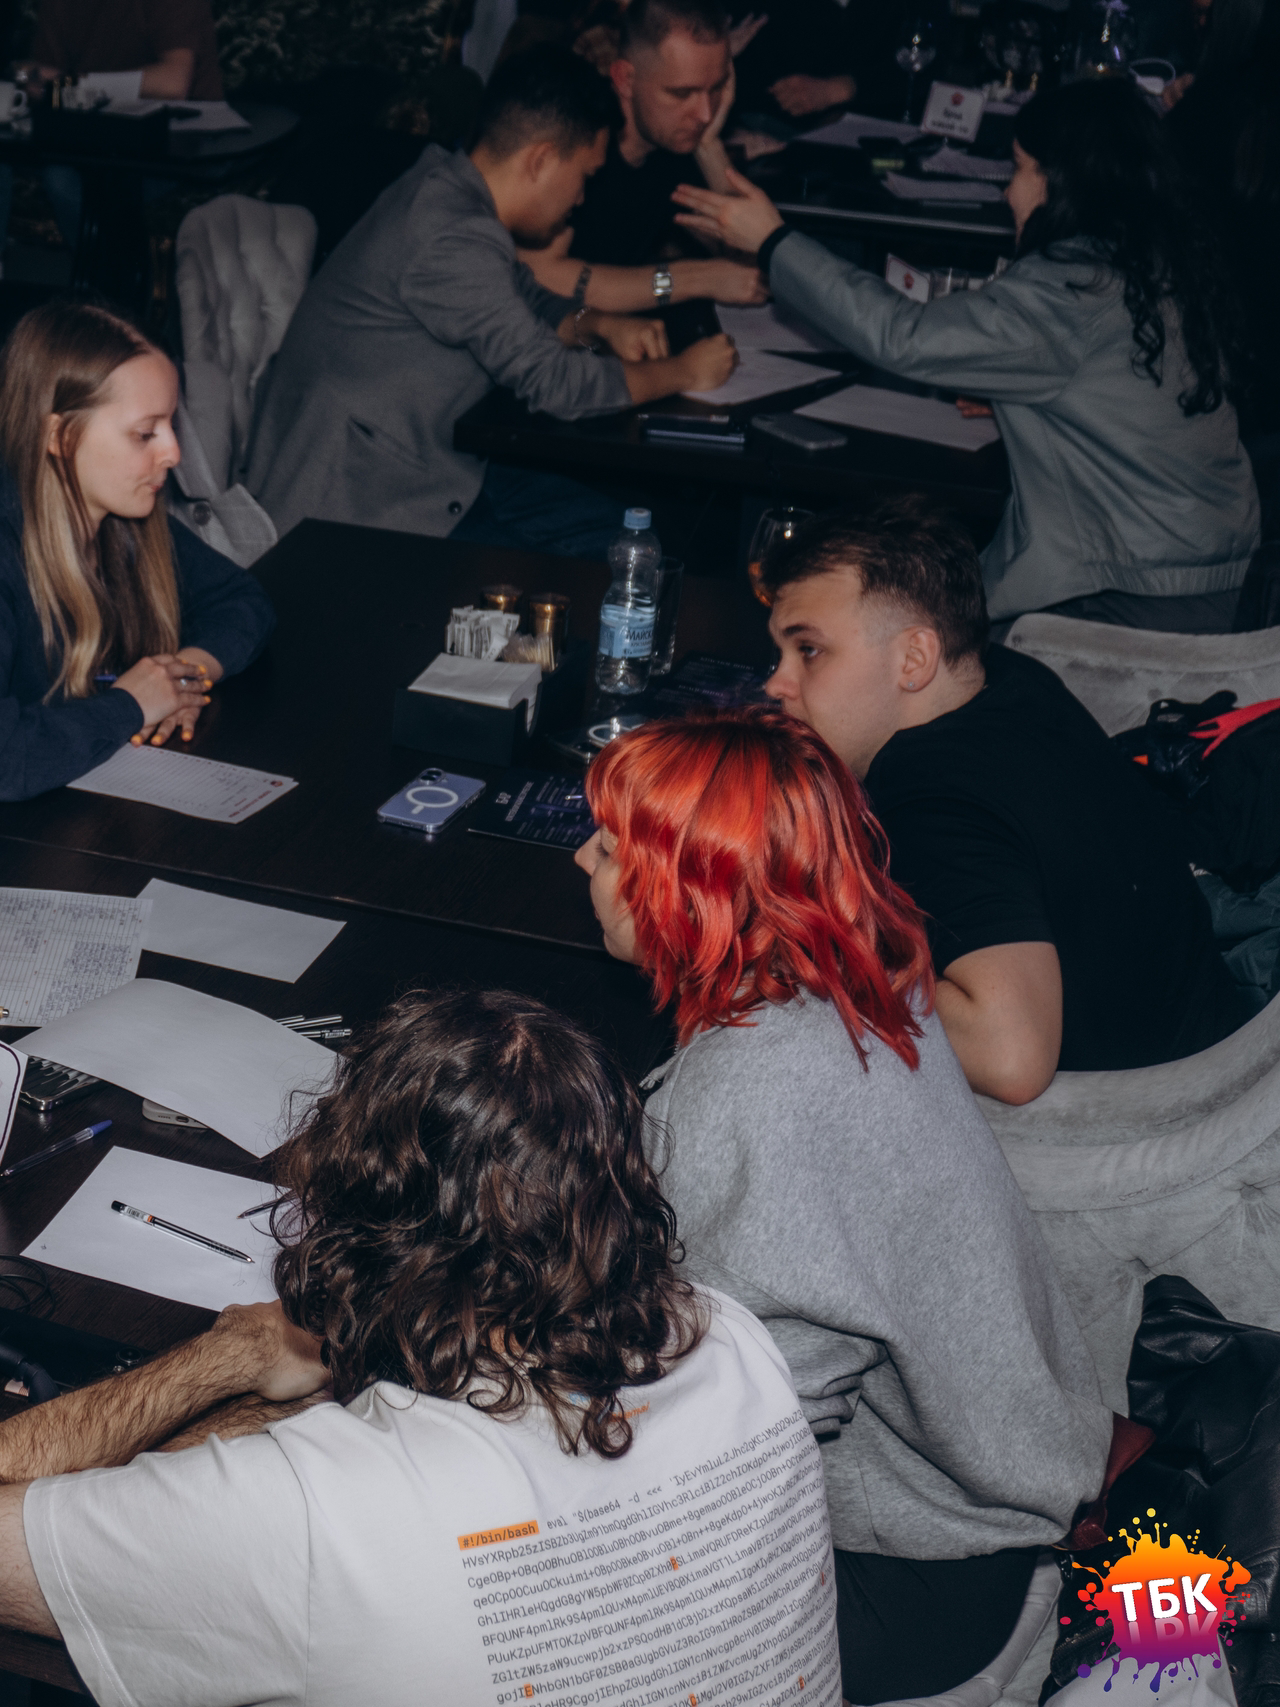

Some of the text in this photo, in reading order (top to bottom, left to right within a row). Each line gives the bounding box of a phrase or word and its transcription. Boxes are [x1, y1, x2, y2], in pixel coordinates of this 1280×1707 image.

[462, 1523, 536, 1548] #!/bin/bash
[547, 1515, 568, 1529] eval
[628, 1491, 640, 1503] -d
